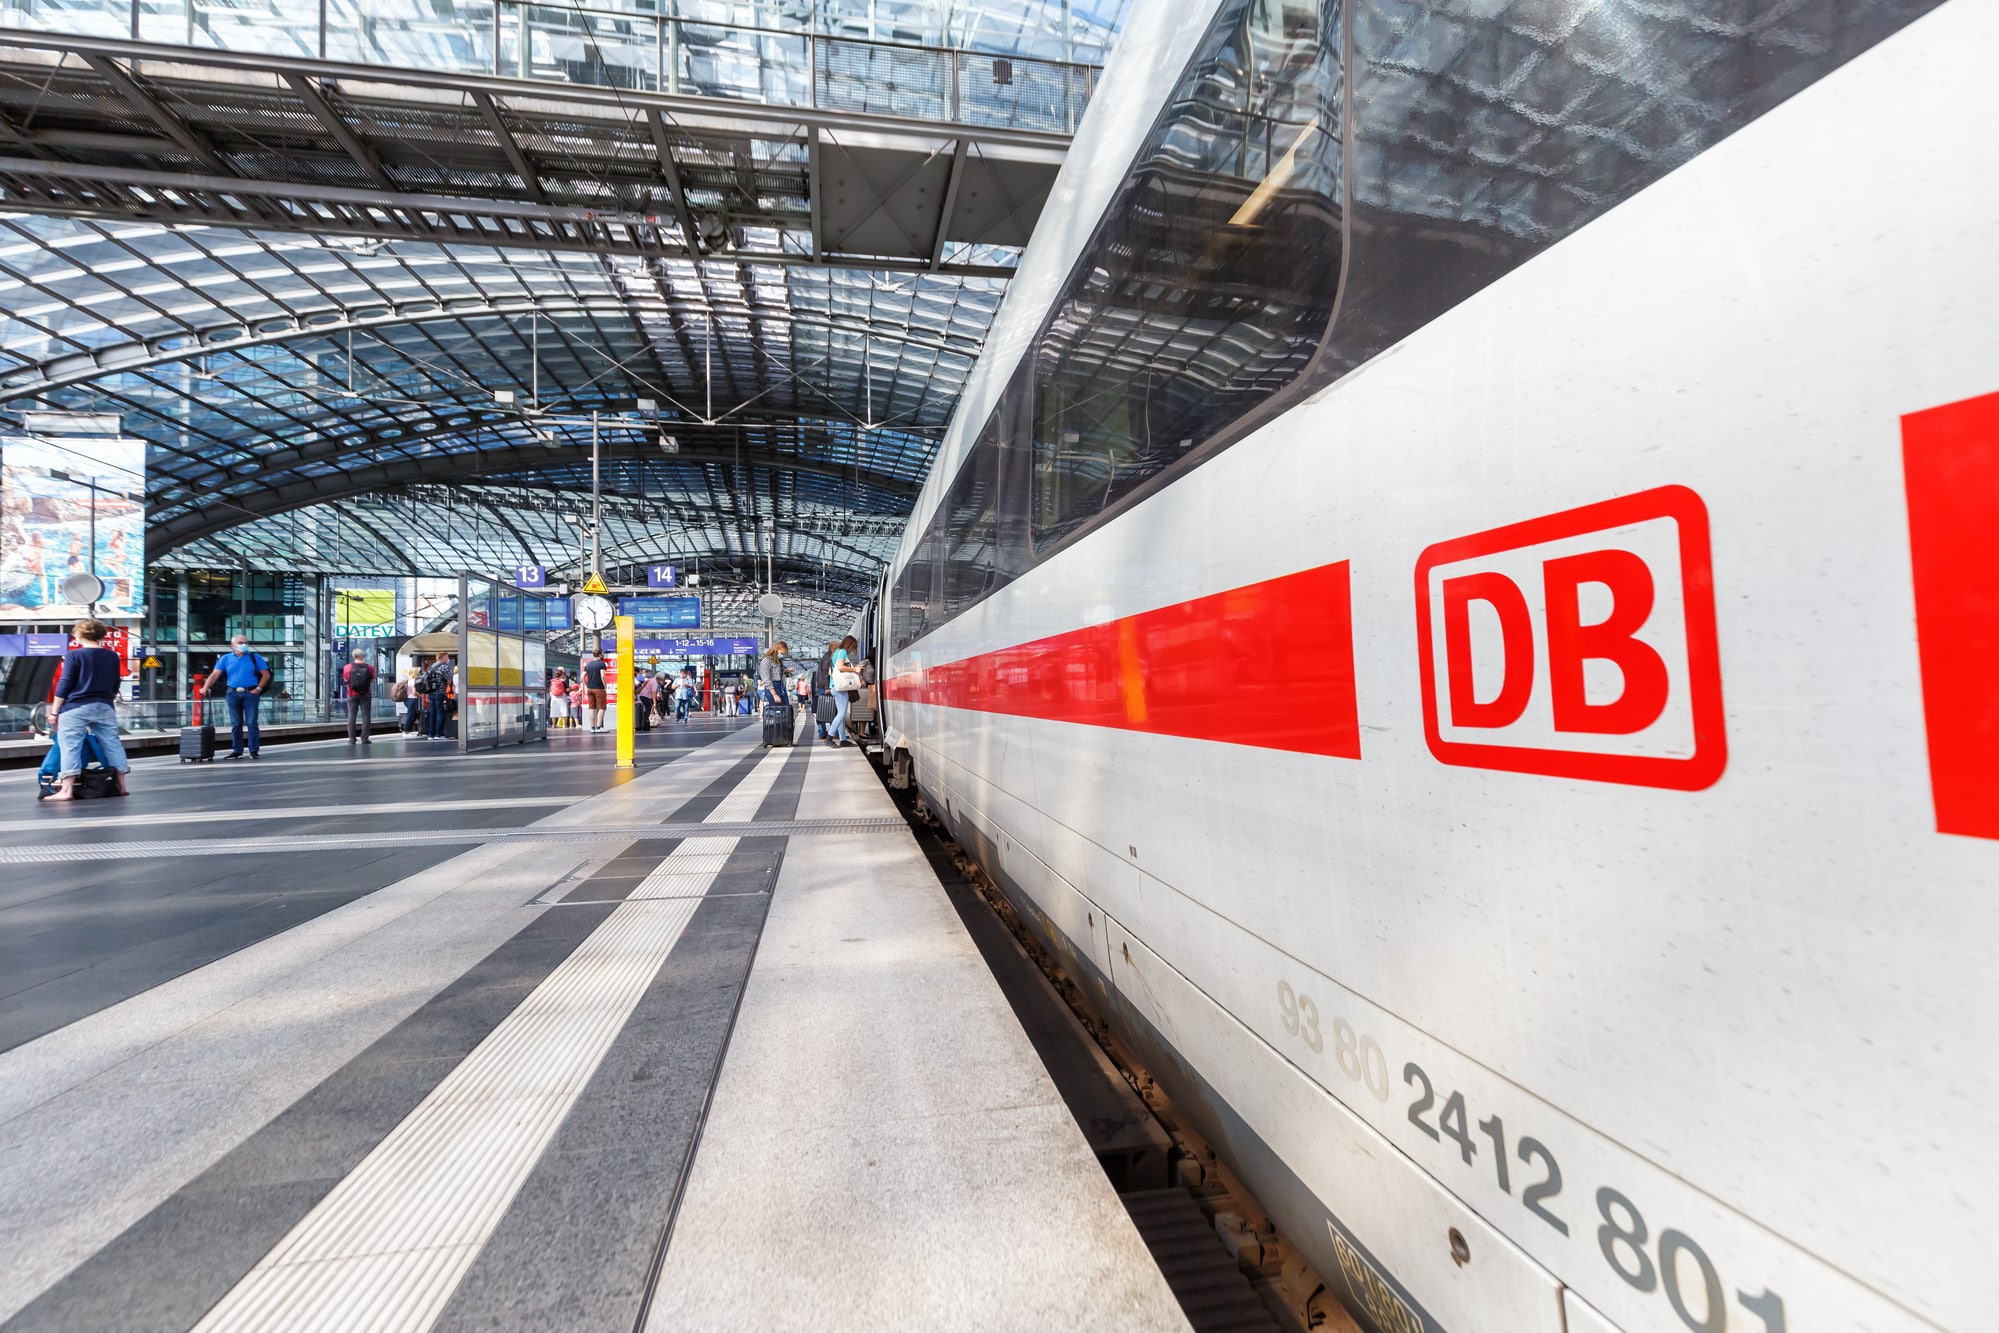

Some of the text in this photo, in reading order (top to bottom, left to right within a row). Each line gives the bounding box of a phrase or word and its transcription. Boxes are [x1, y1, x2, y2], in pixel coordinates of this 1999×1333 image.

[518, 566, 539, 583] 13
[653, 566, 673, 583] 14
[336, 625, 394, 638] DATEV
[337, 641, 345, 651] F
[675, 639, 690, 647] 1-12
[696, 639, 715, 647] 15-16
[1443, 549, 1669, 735] DB
[1277, 979, 1323, 1054] 93
[1333, 1016, 1389, 1102] 80
[1403, 1062, 1569, 1238] 2412
